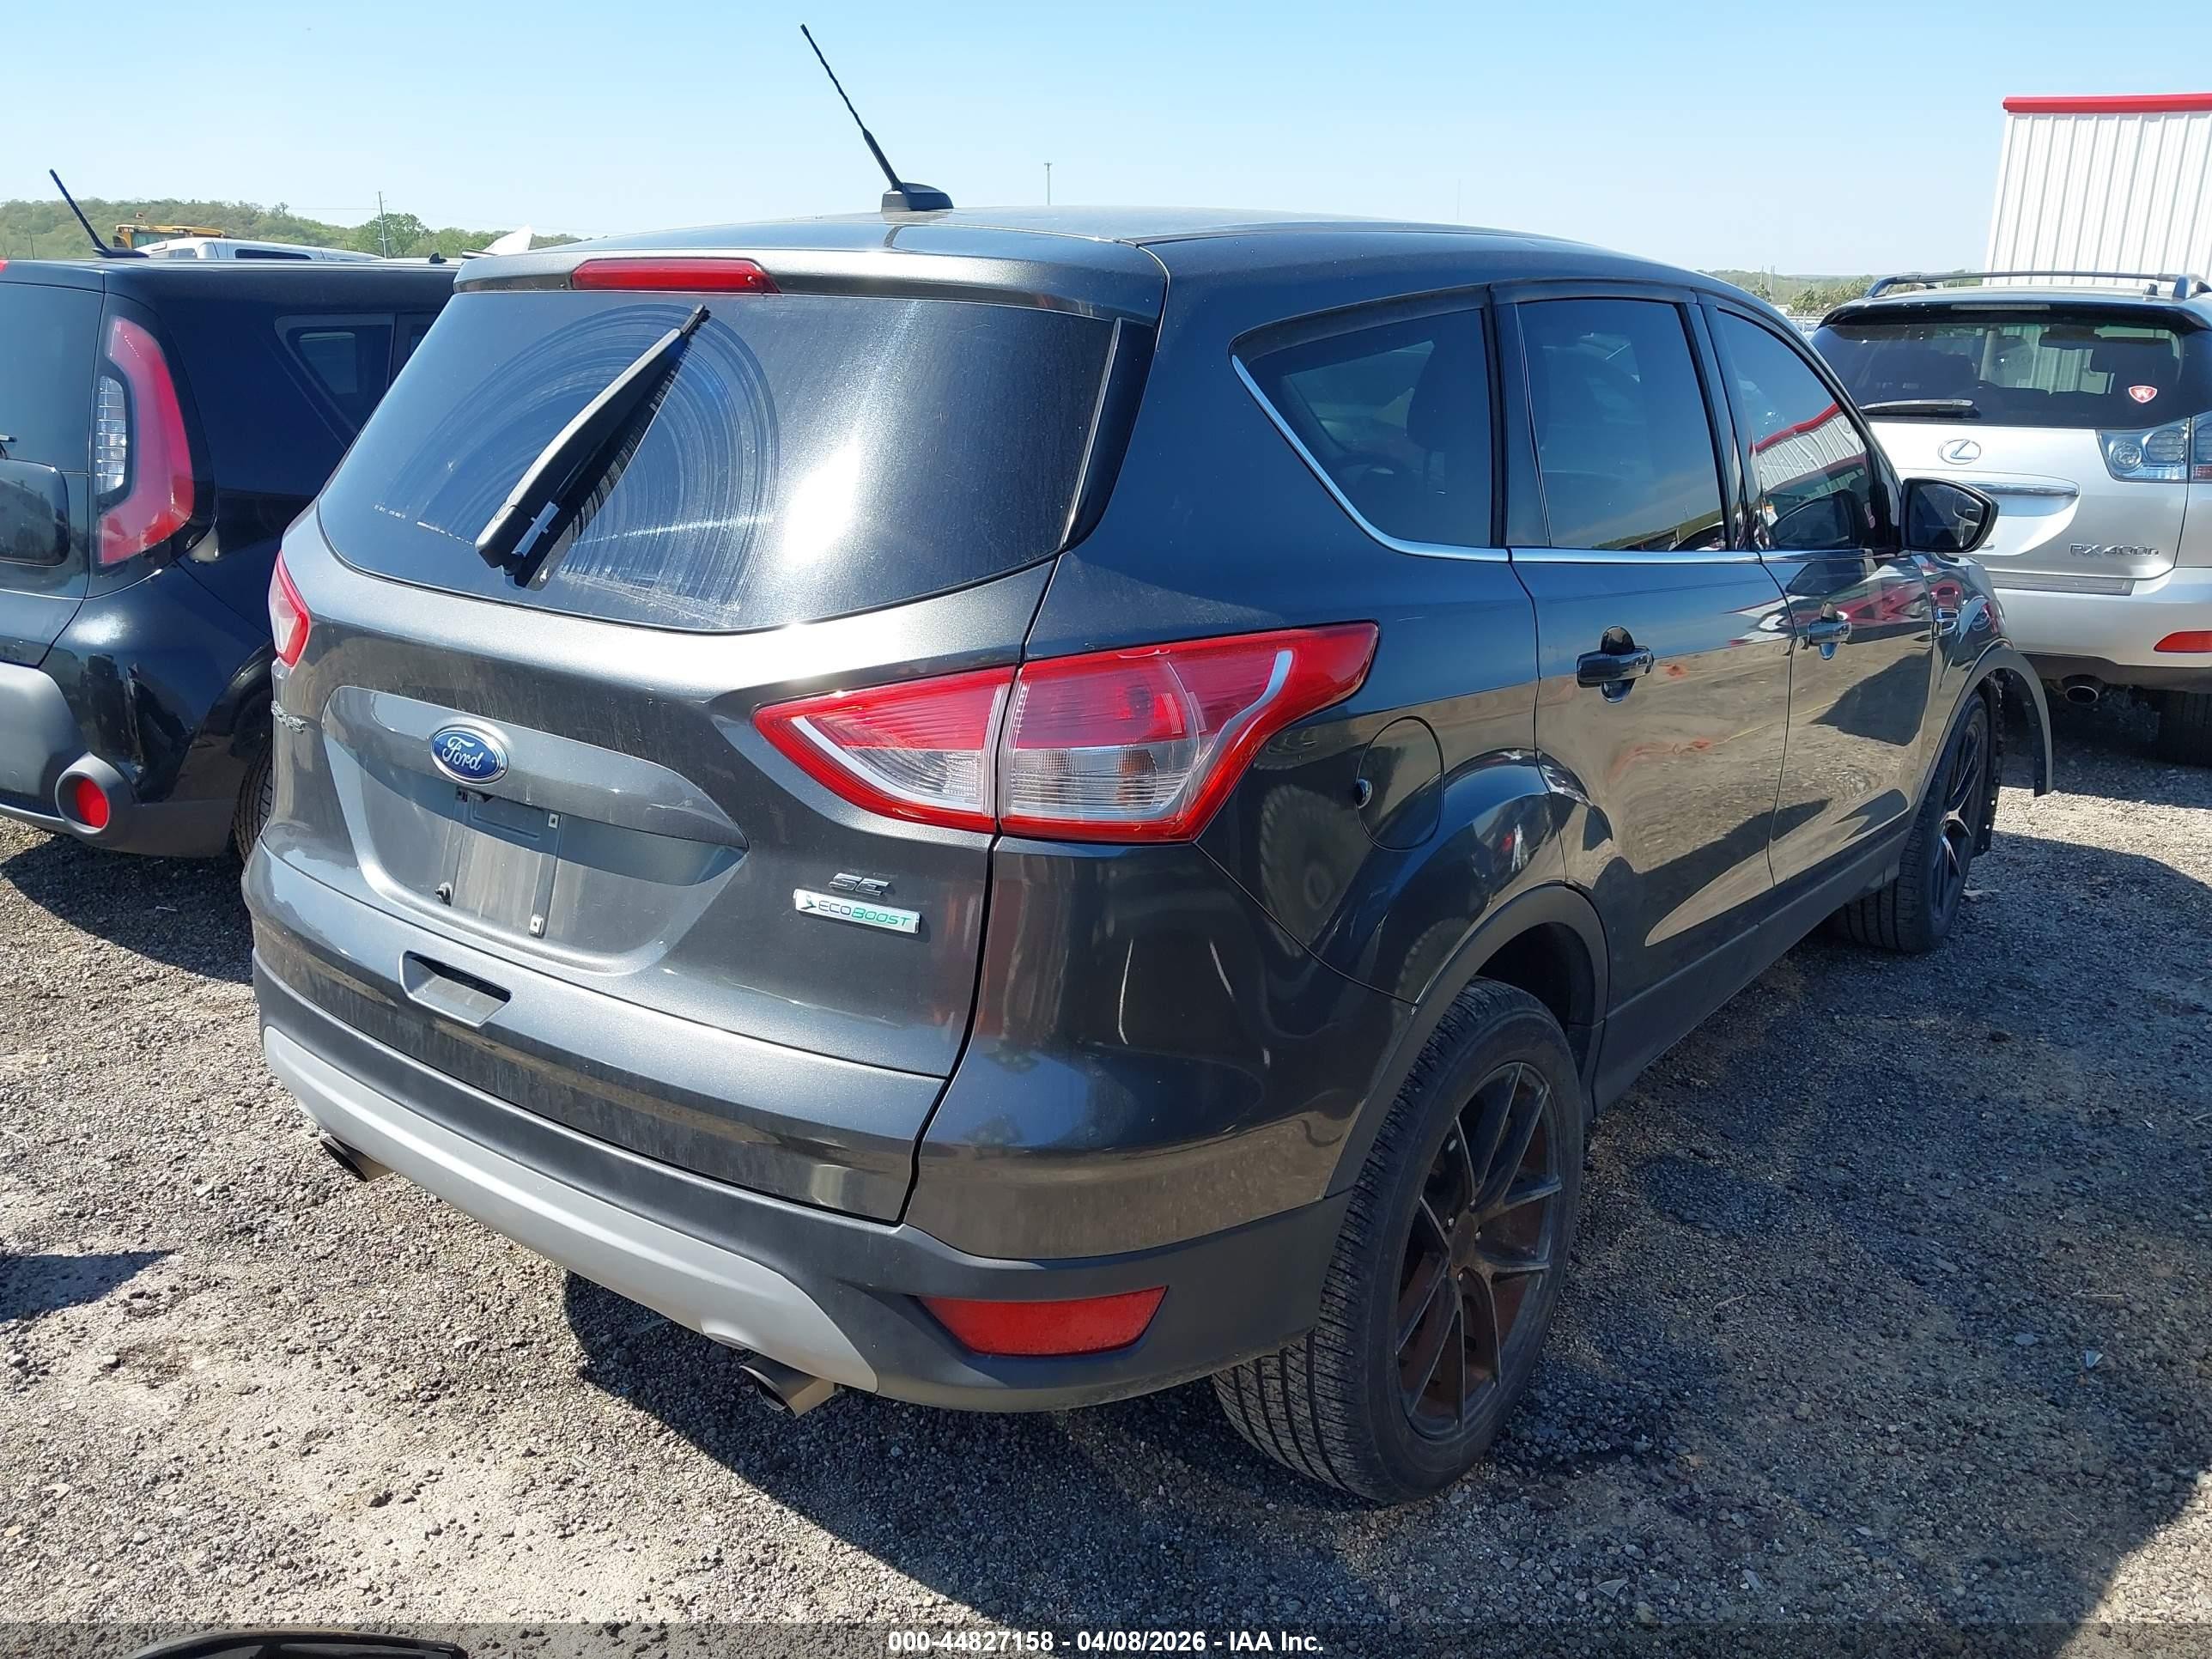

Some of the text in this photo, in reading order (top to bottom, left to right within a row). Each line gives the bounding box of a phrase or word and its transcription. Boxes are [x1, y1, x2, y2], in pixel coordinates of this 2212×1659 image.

[441, 736, 485, 771] Ford
[828, 872, 891, 896] SE
[818, 900, 912, 927] ECOBOOST
